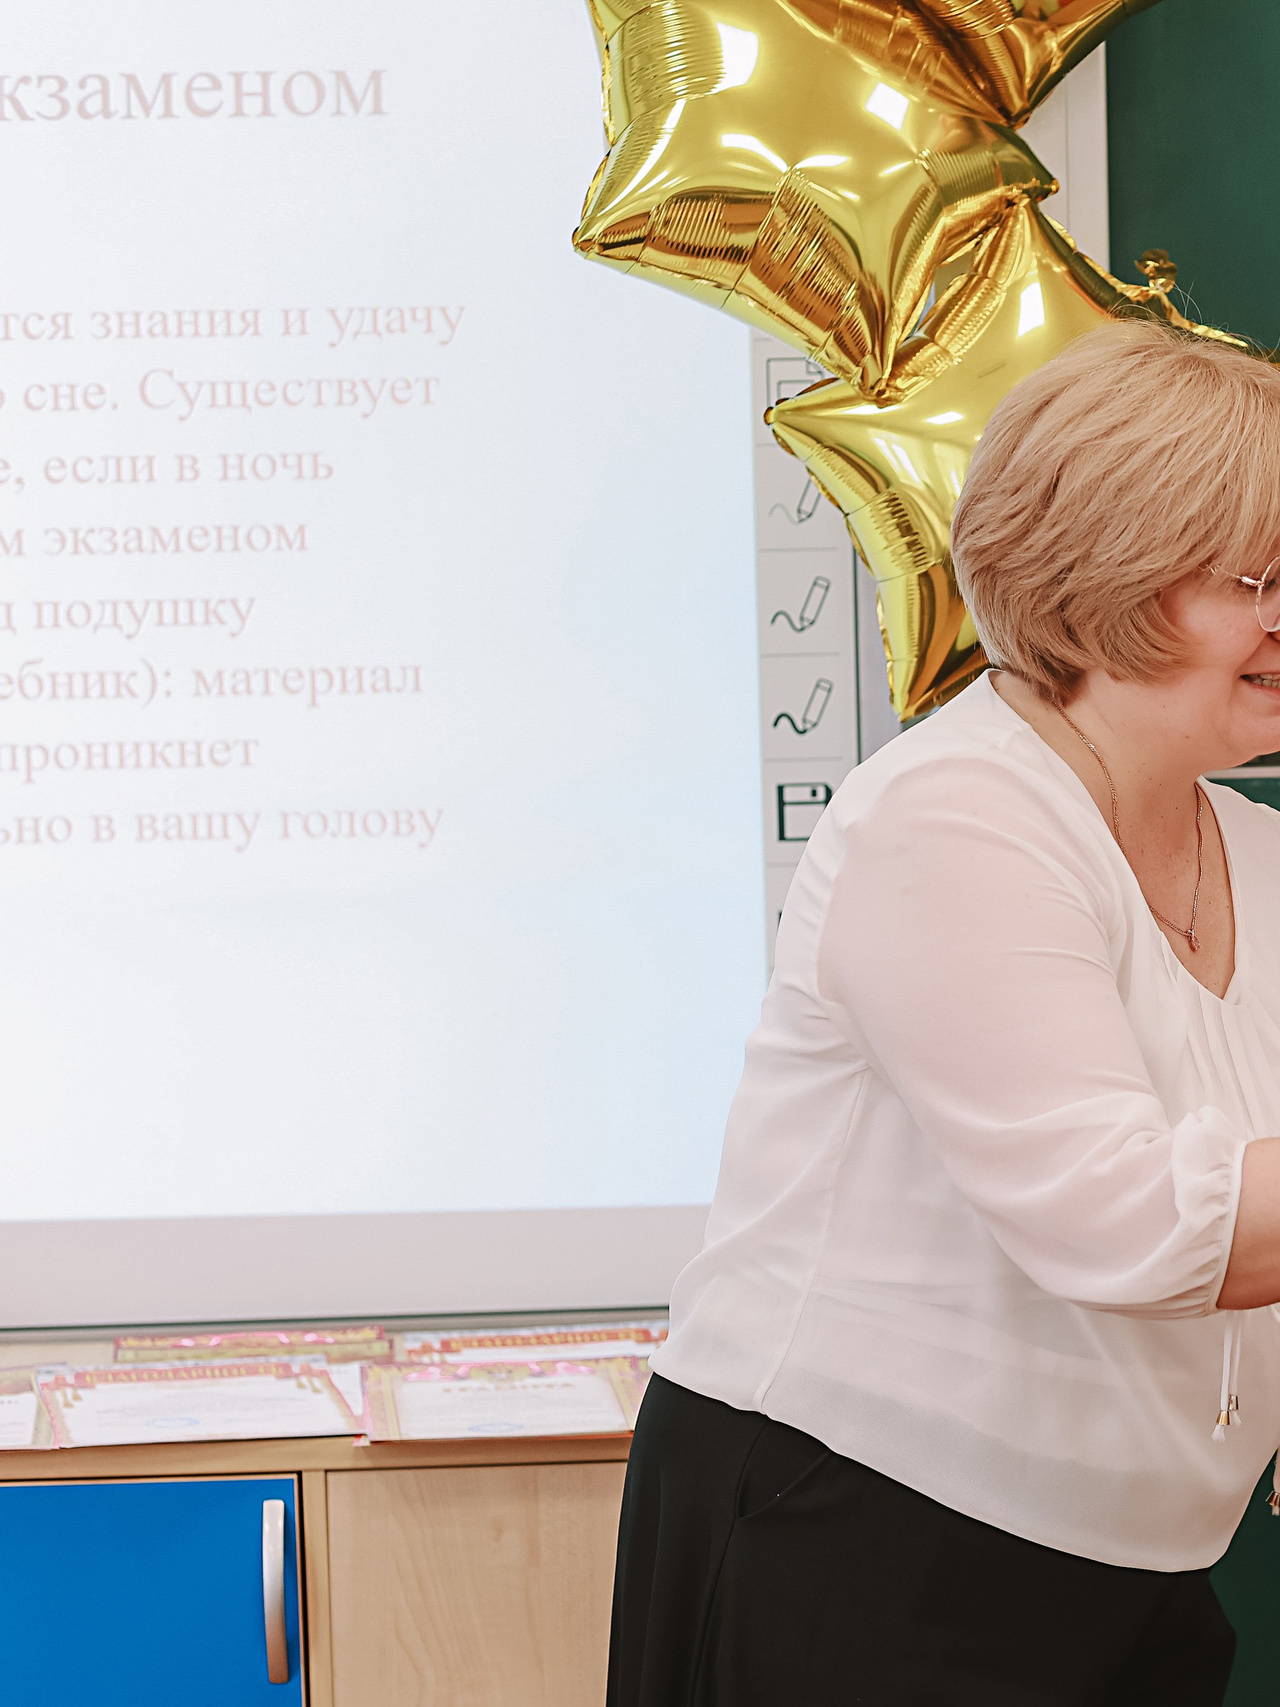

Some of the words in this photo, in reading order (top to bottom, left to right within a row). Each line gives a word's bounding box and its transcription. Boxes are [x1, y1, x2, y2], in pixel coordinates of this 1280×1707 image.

[0, 68, 389, 121] кзаменом
[90, 309, 262, 340] знания
[280, 307, 310, 336] и
[326, 305, 466, 348] удачу
[23, 380, 119, 412] сне.
[139, 368, 440, 420] Существует
[43, 456, 157, 485] если
[174, 454, 202, 482] в
[218, 452, 334, 483] ночь
[43, 522, 309, 556] экзаменом
[33, 597, 257, 640] подушку
[191, 664, 424, 708] материал
[0, 736, 260, 785] проникнет
[91, 813, 117, 843] в
[134, 810, 262, 853] вашу
[278, 808, 445, 849] голову
